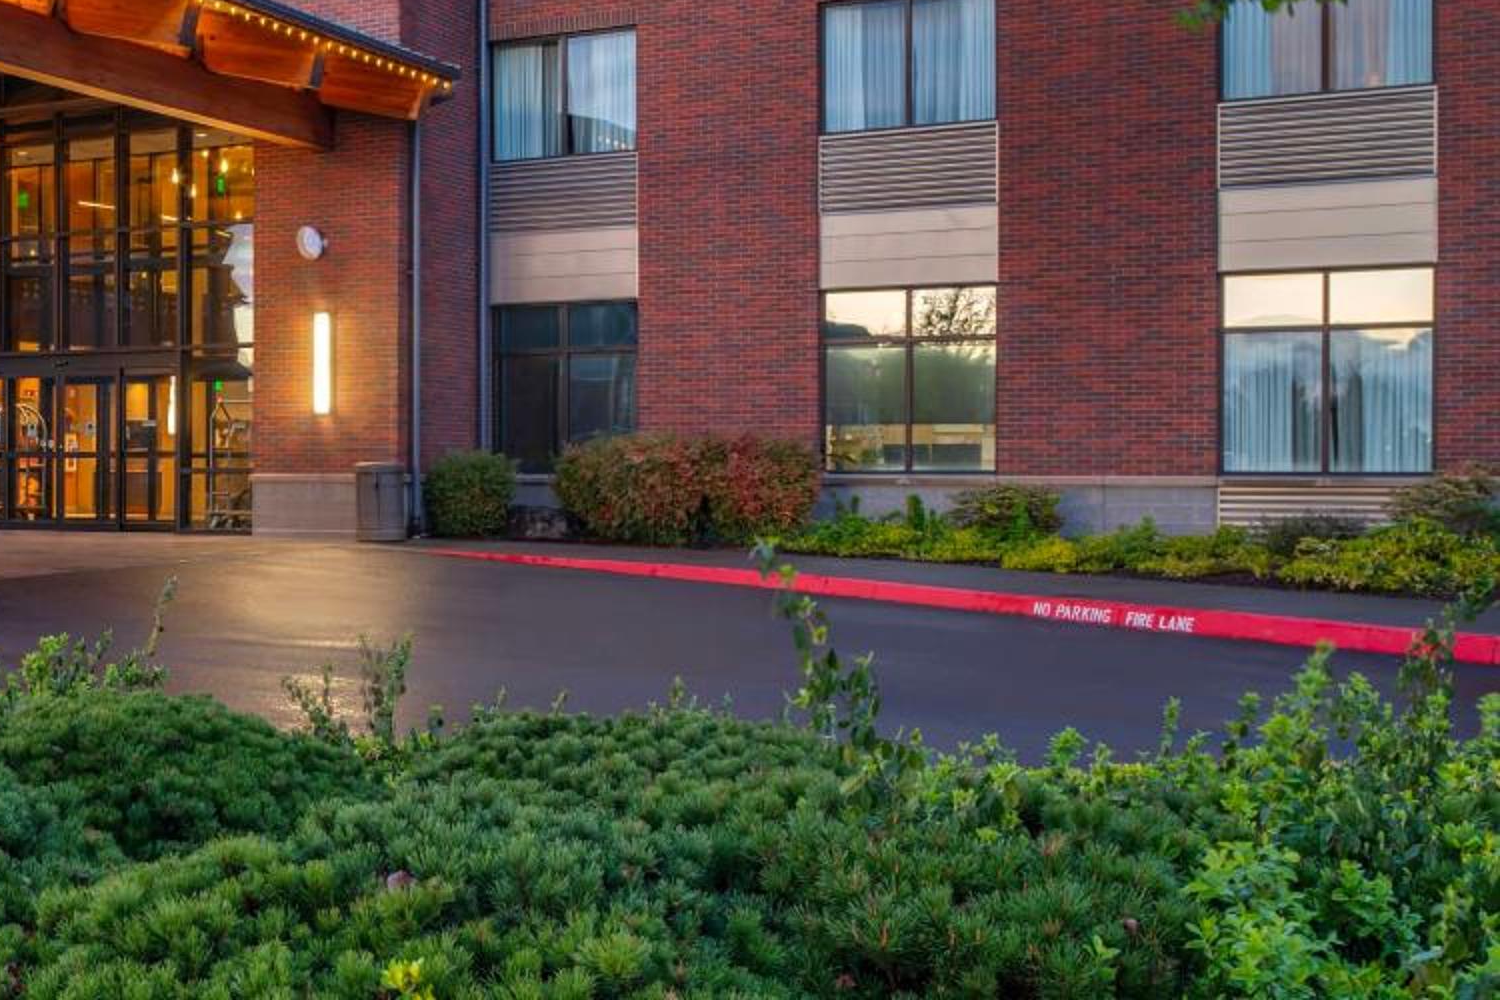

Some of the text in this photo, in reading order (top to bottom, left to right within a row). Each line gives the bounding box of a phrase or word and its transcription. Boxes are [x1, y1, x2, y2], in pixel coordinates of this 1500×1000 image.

[1033, 601, 1195, 632] NO PARKING FIRE LANE
